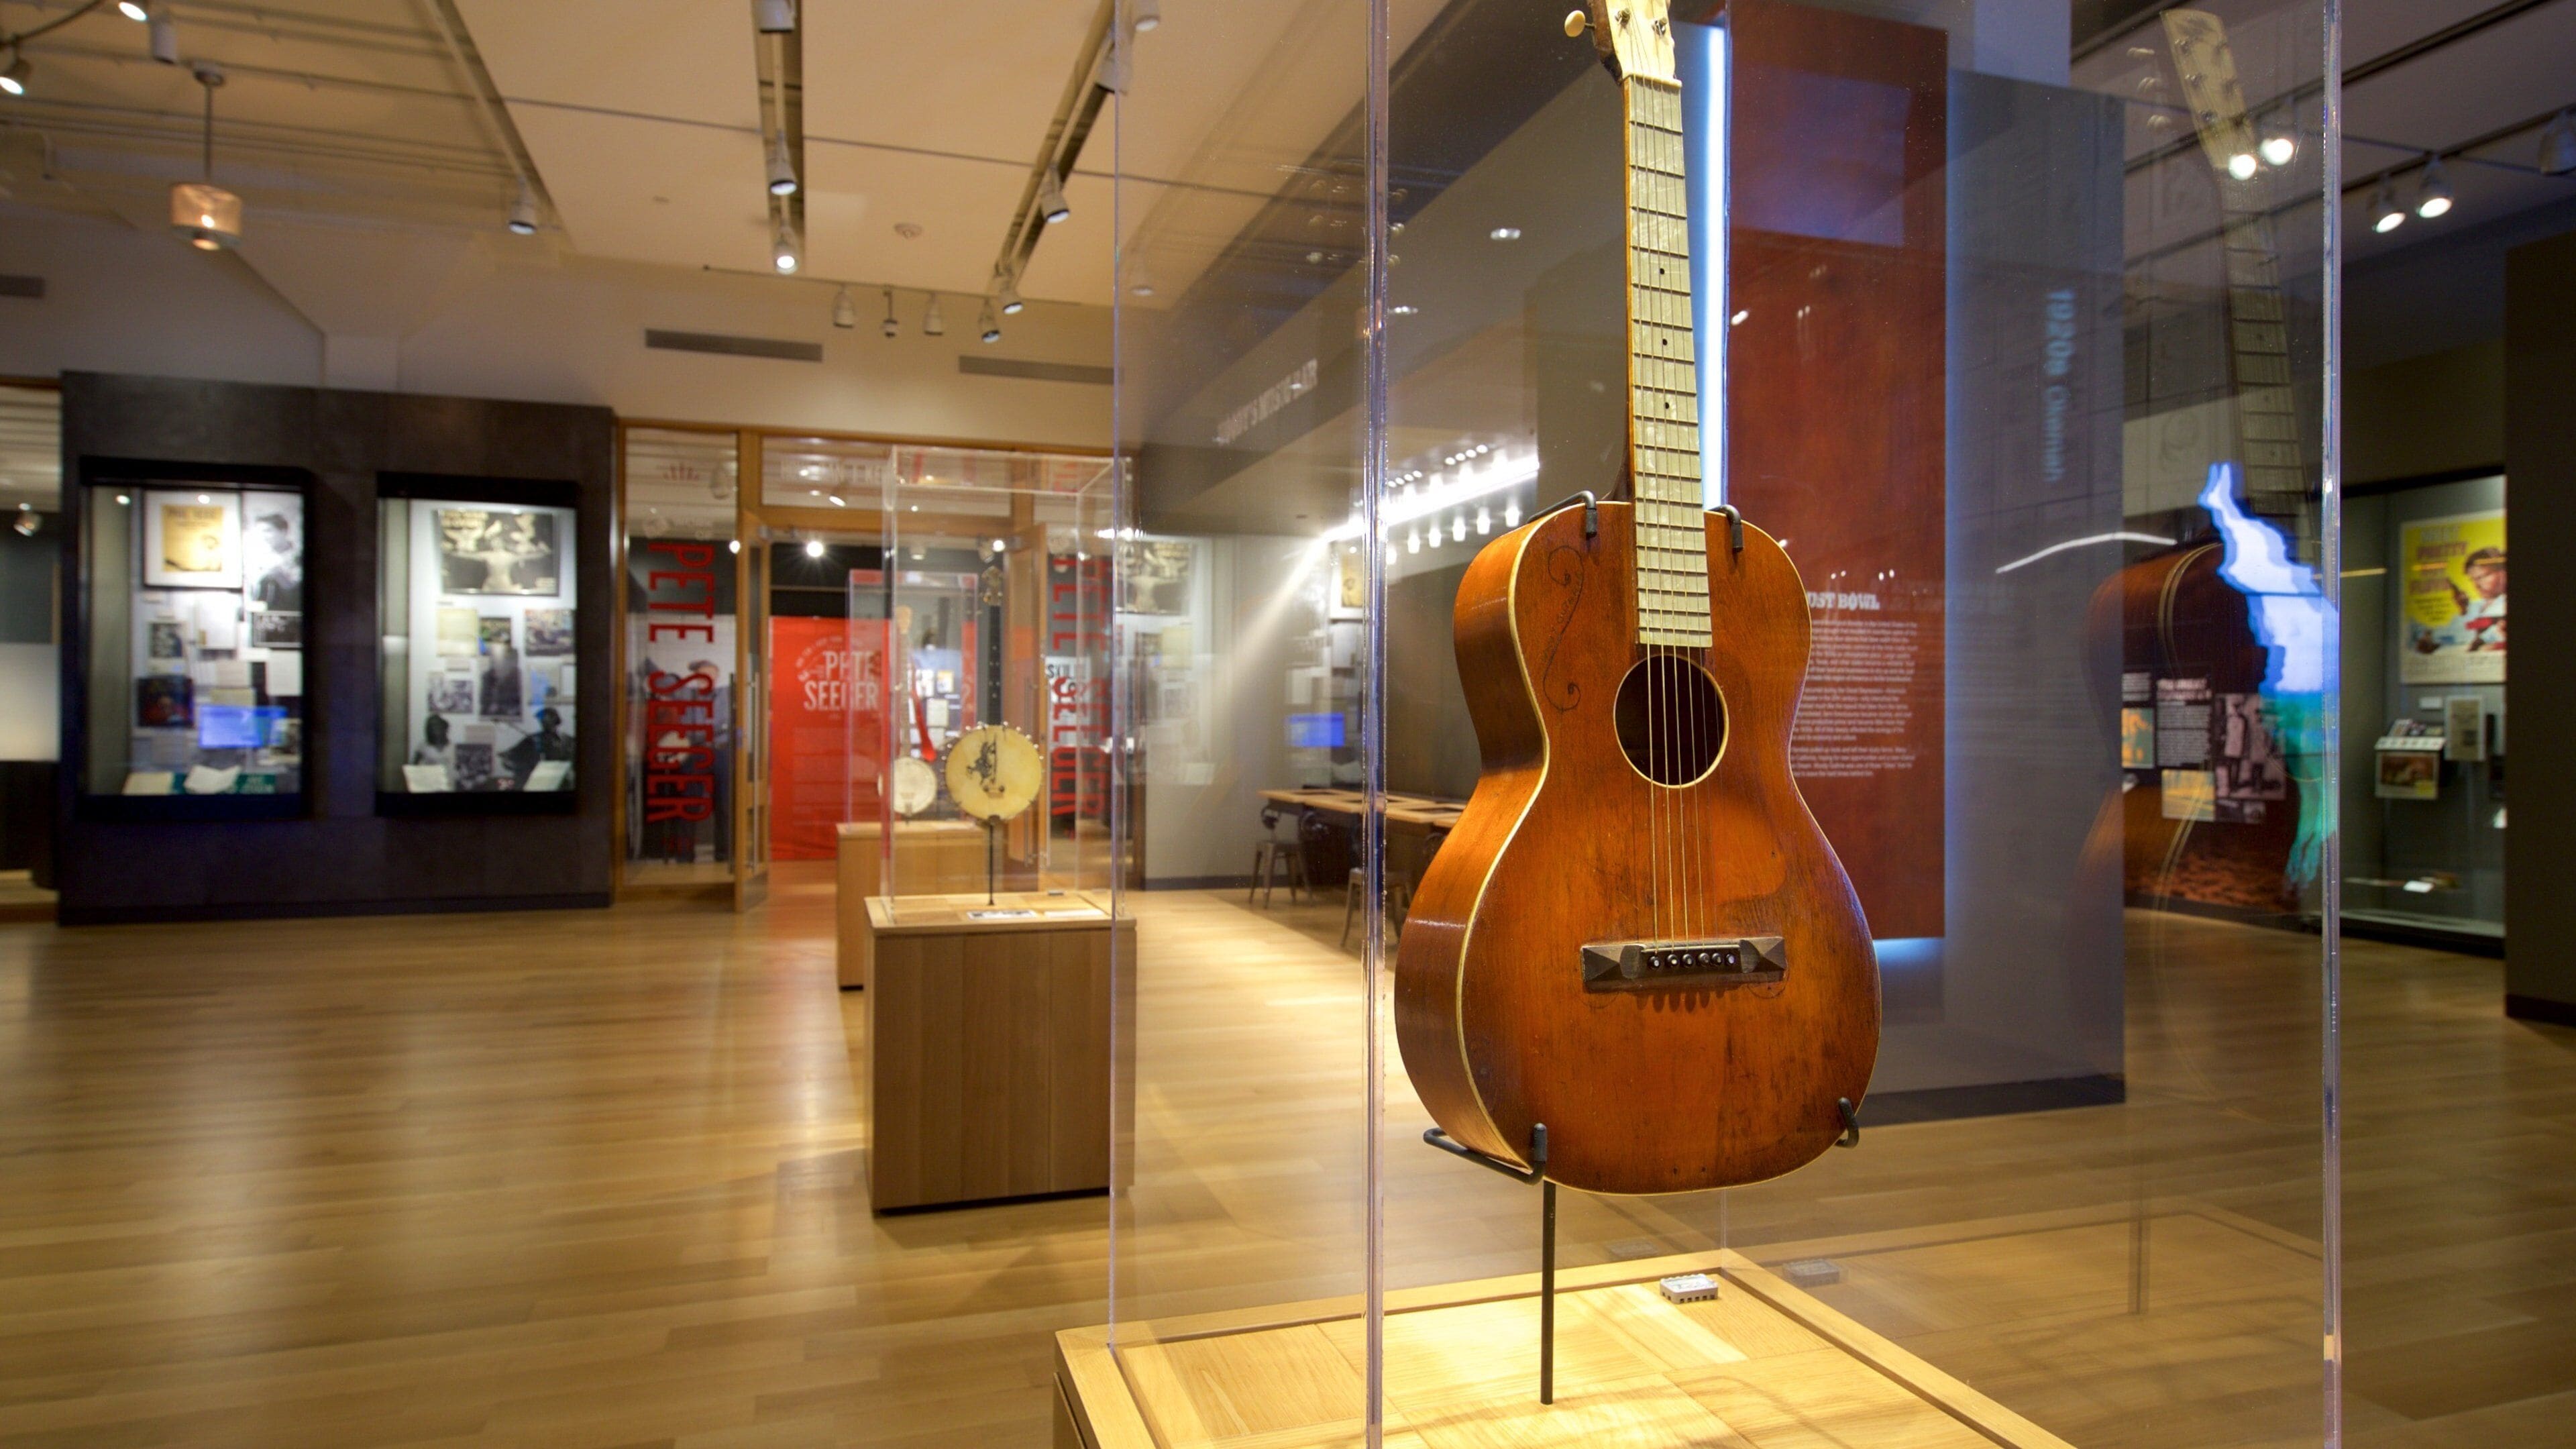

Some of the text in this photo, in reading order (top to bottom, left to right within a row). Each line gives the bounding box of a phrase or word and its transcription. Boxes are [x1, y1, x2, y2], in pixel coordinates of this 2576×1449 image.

[649, 543, 714, 643] PETE
[1807, 591, 1880, 611] UST BOWL
[823, 650, 875, 680] PETE
[646, 670, 715, 823] SEEGER
